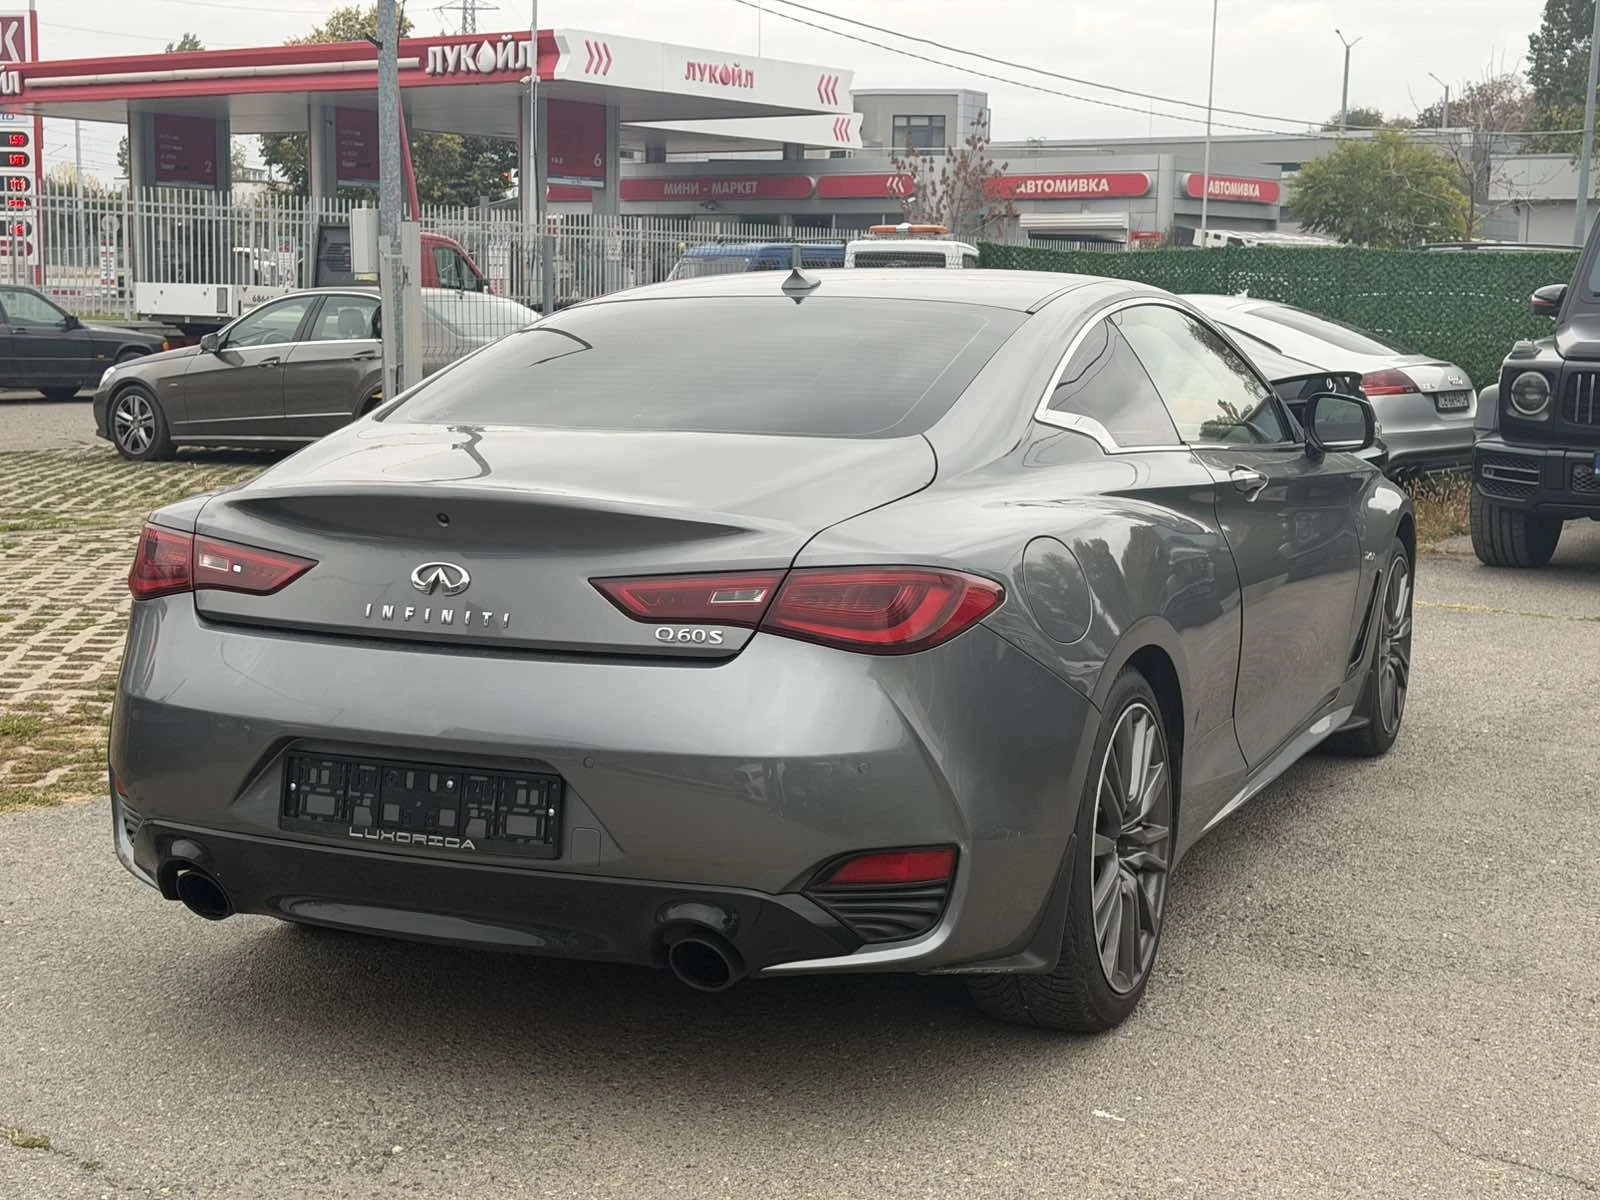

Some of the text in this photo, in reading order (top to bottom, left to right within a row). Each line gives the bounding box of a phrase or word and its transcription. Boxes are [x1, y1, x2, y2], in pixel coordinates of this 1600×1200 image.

[425, 34, 535, 74] ЛУКОЙЛ
[685, 62, 754, 89] ЛУКОЙЛ
[593, 152, 602, 167] 6
[664, 182, 700, 195] МИНИ
[711, 181, 759, 194] МАРКЕТ
[1016, 177, 1110, 194] АВТОМИВКА
[1207, 179, 1261, 197] АВТОМИВКА
[365, 603, 511, 628] INFINITI
[655, 626, 724, 645] Q60S
[348, 826, 477, 851] LUXORICA
